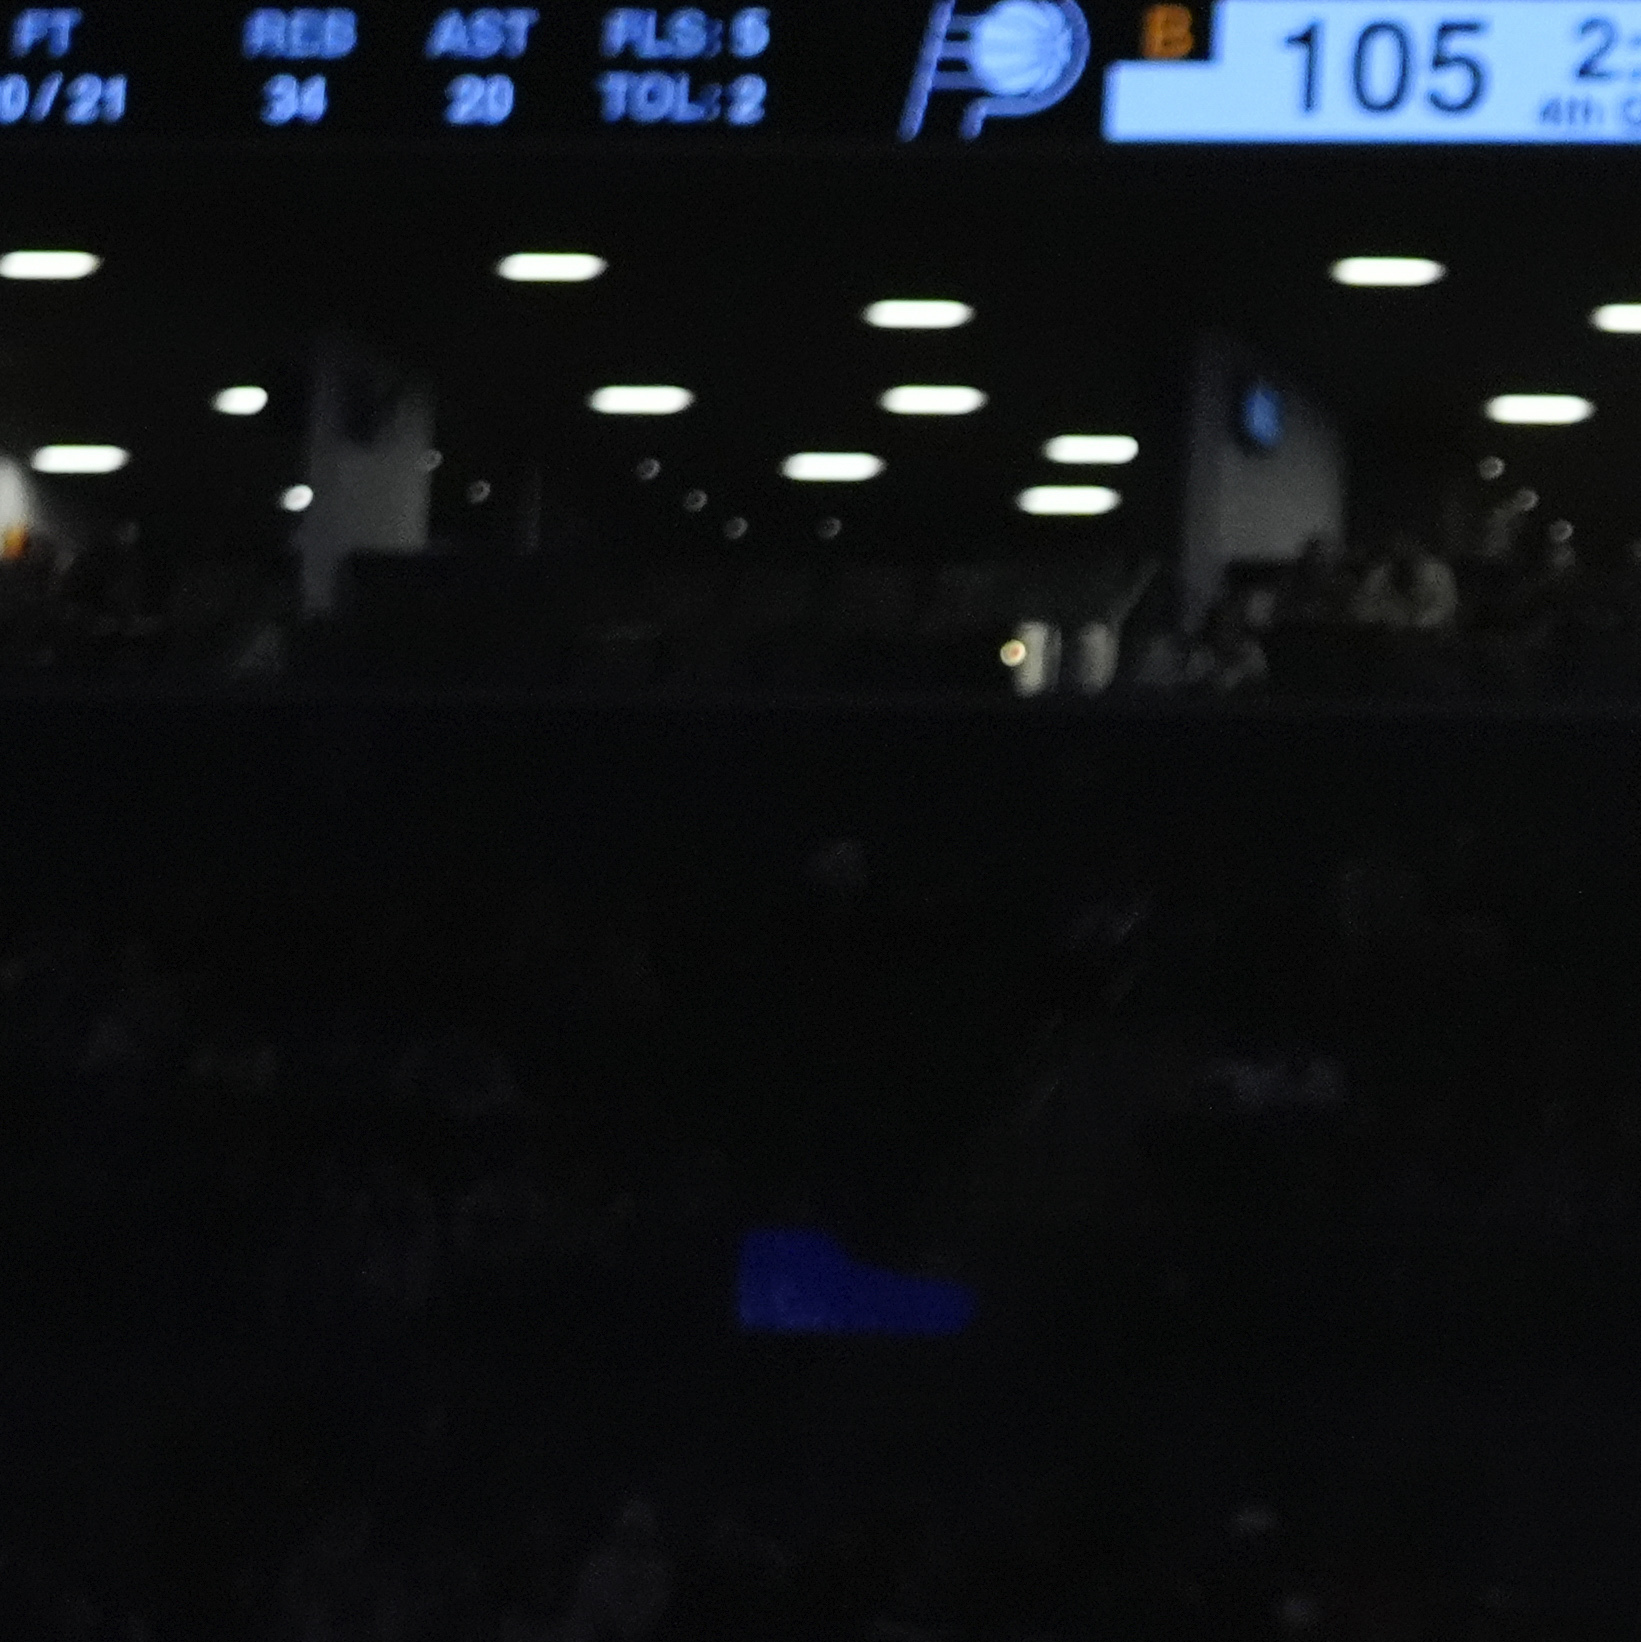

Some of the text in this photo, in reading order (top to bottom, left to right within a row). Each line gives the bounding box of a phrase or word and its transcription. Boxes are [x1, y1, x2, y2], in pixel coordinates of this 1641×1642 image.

[426, 8, 538, 59] AST
[1282, 20, 1491, 116] 105
[446, 74, 515, 125] 20
